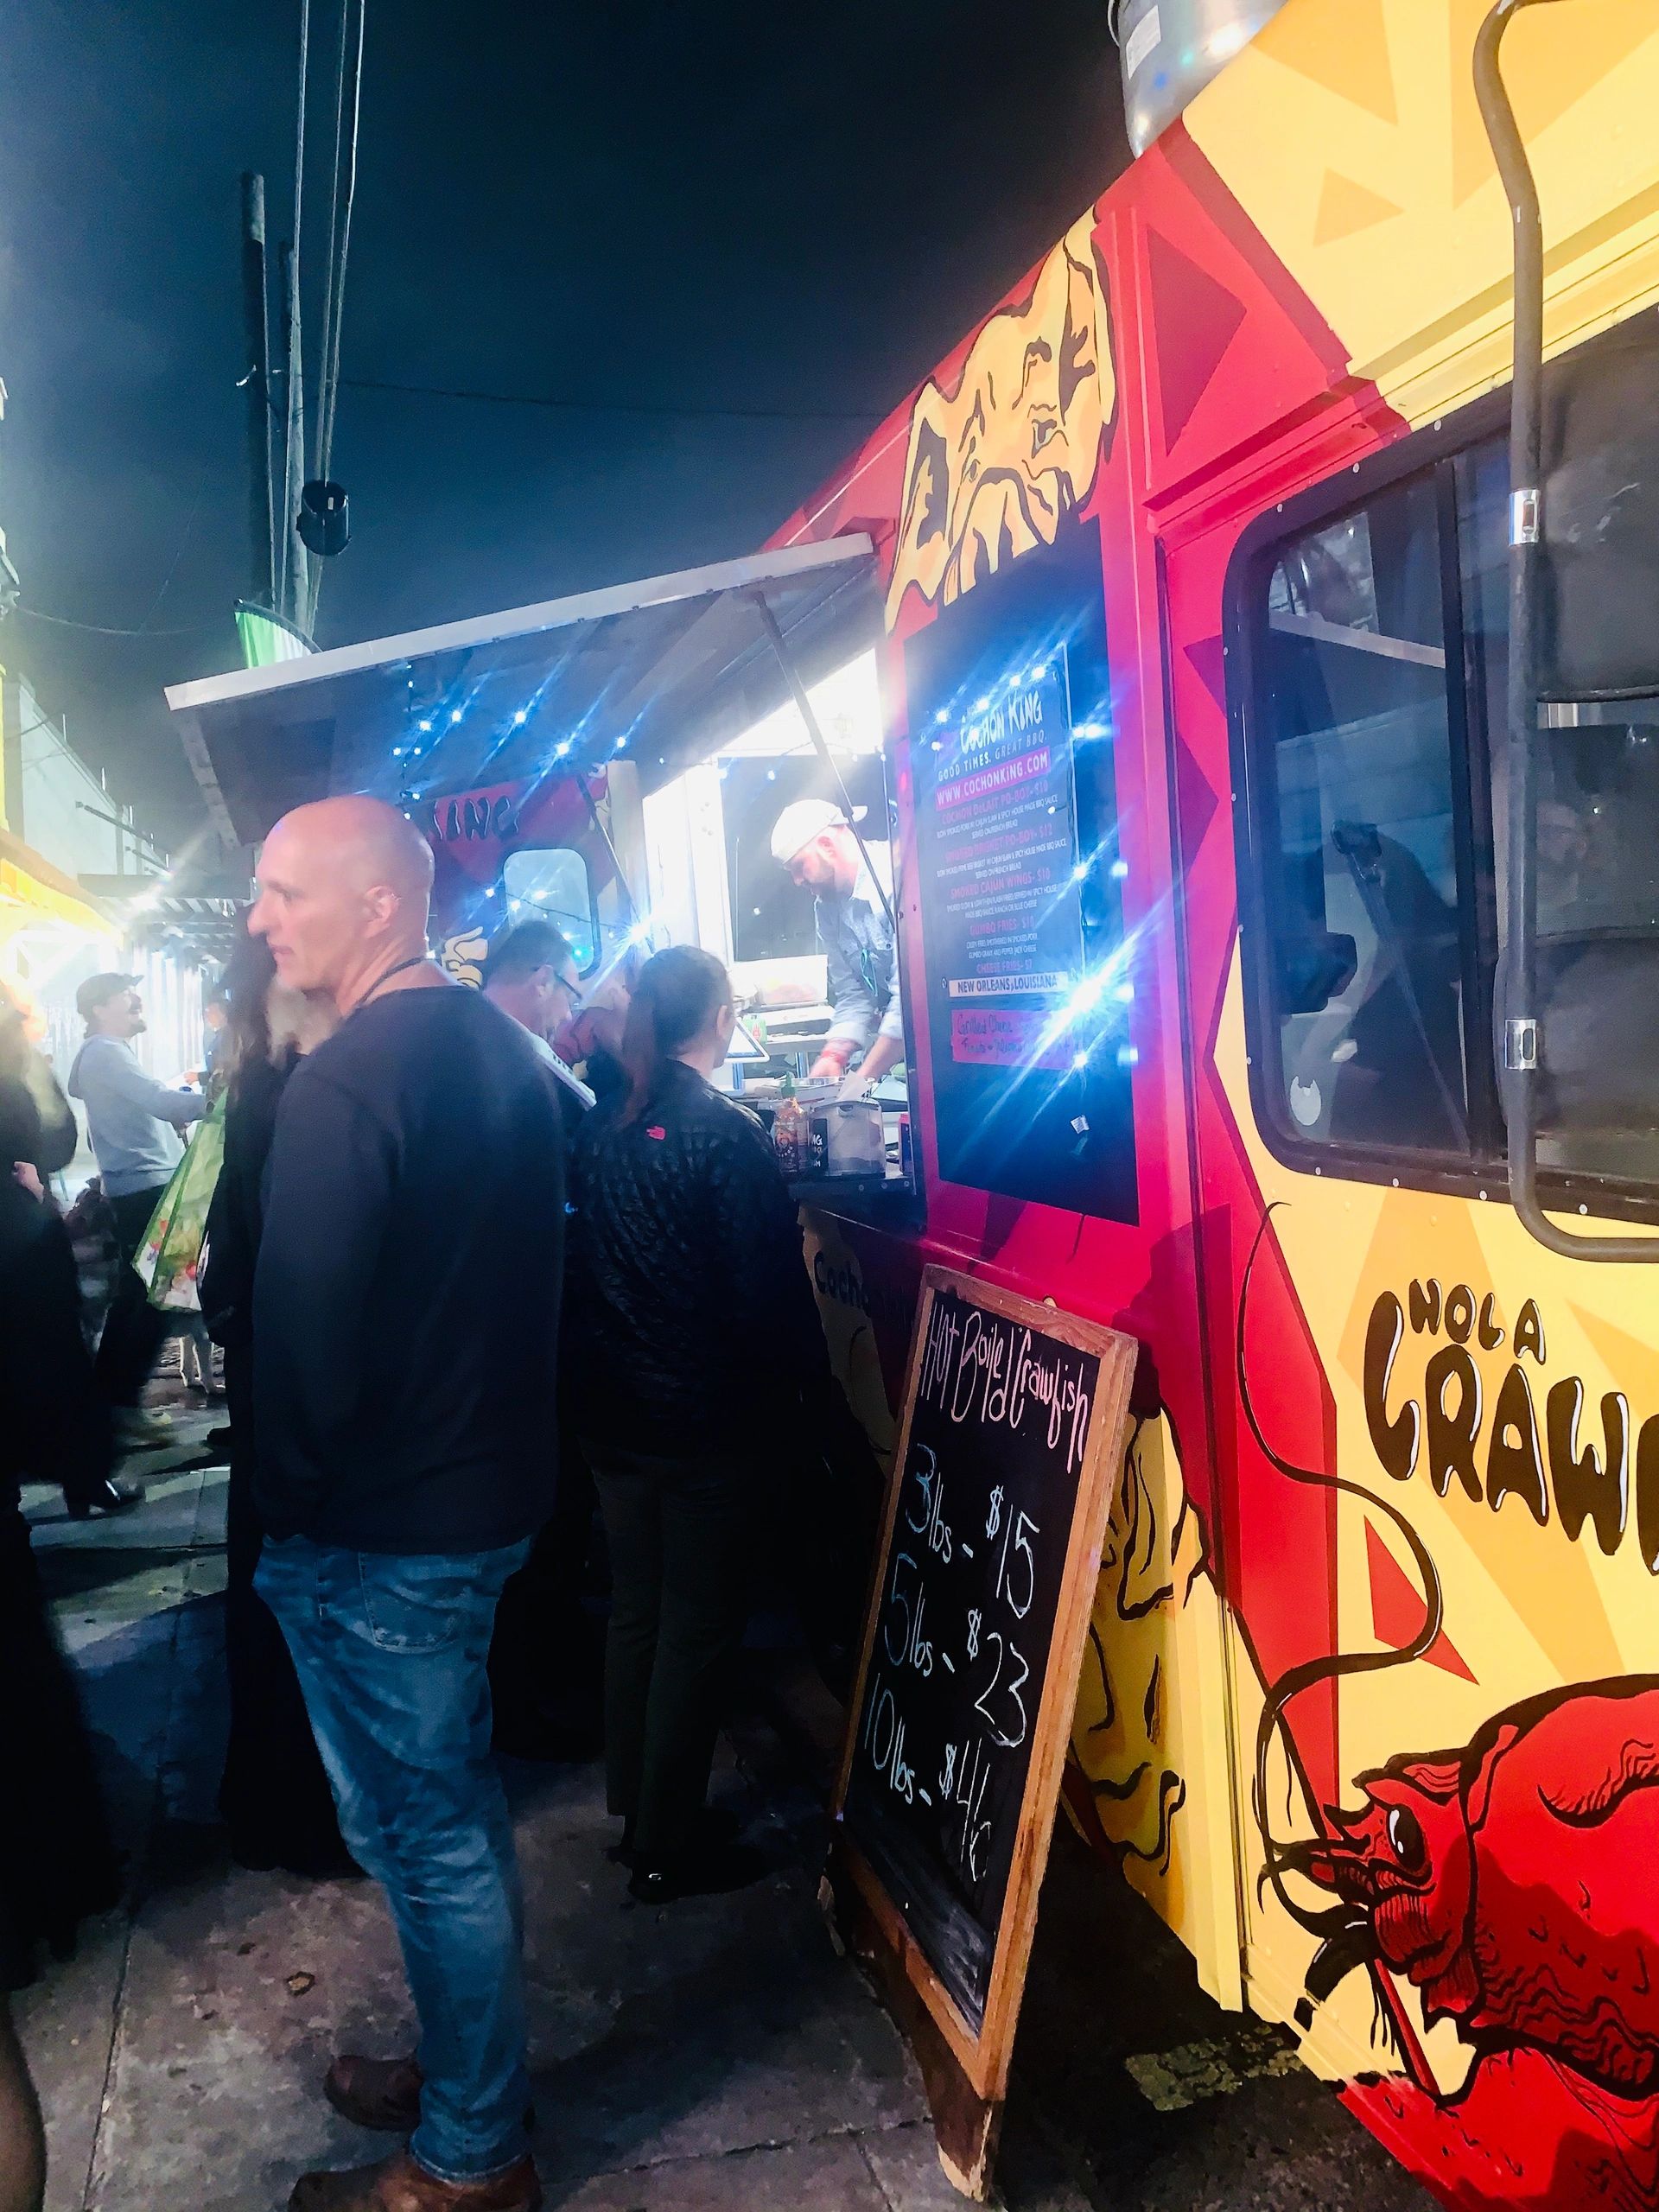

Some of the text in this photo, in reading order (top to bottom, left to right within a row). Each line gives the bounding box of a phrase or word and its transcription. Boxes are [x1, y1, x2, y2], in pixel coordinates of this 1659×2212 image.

[938, 764, 961, 782] GOOD
[995, 737, 1023, 760] GREAT
[957, 979, 975, 993] NEW
[1014, 974, 1058, 990] LOUISIANA
[1408, 1278, 1547, 1365] HOLA
[1009, 1328, 1089, 1475] Crawfish
[1363, 1291, 1659, 1577] CRAW
[985, 1484, 1040, 1619] $15
[966, 1608, 1029, 1747] $23
